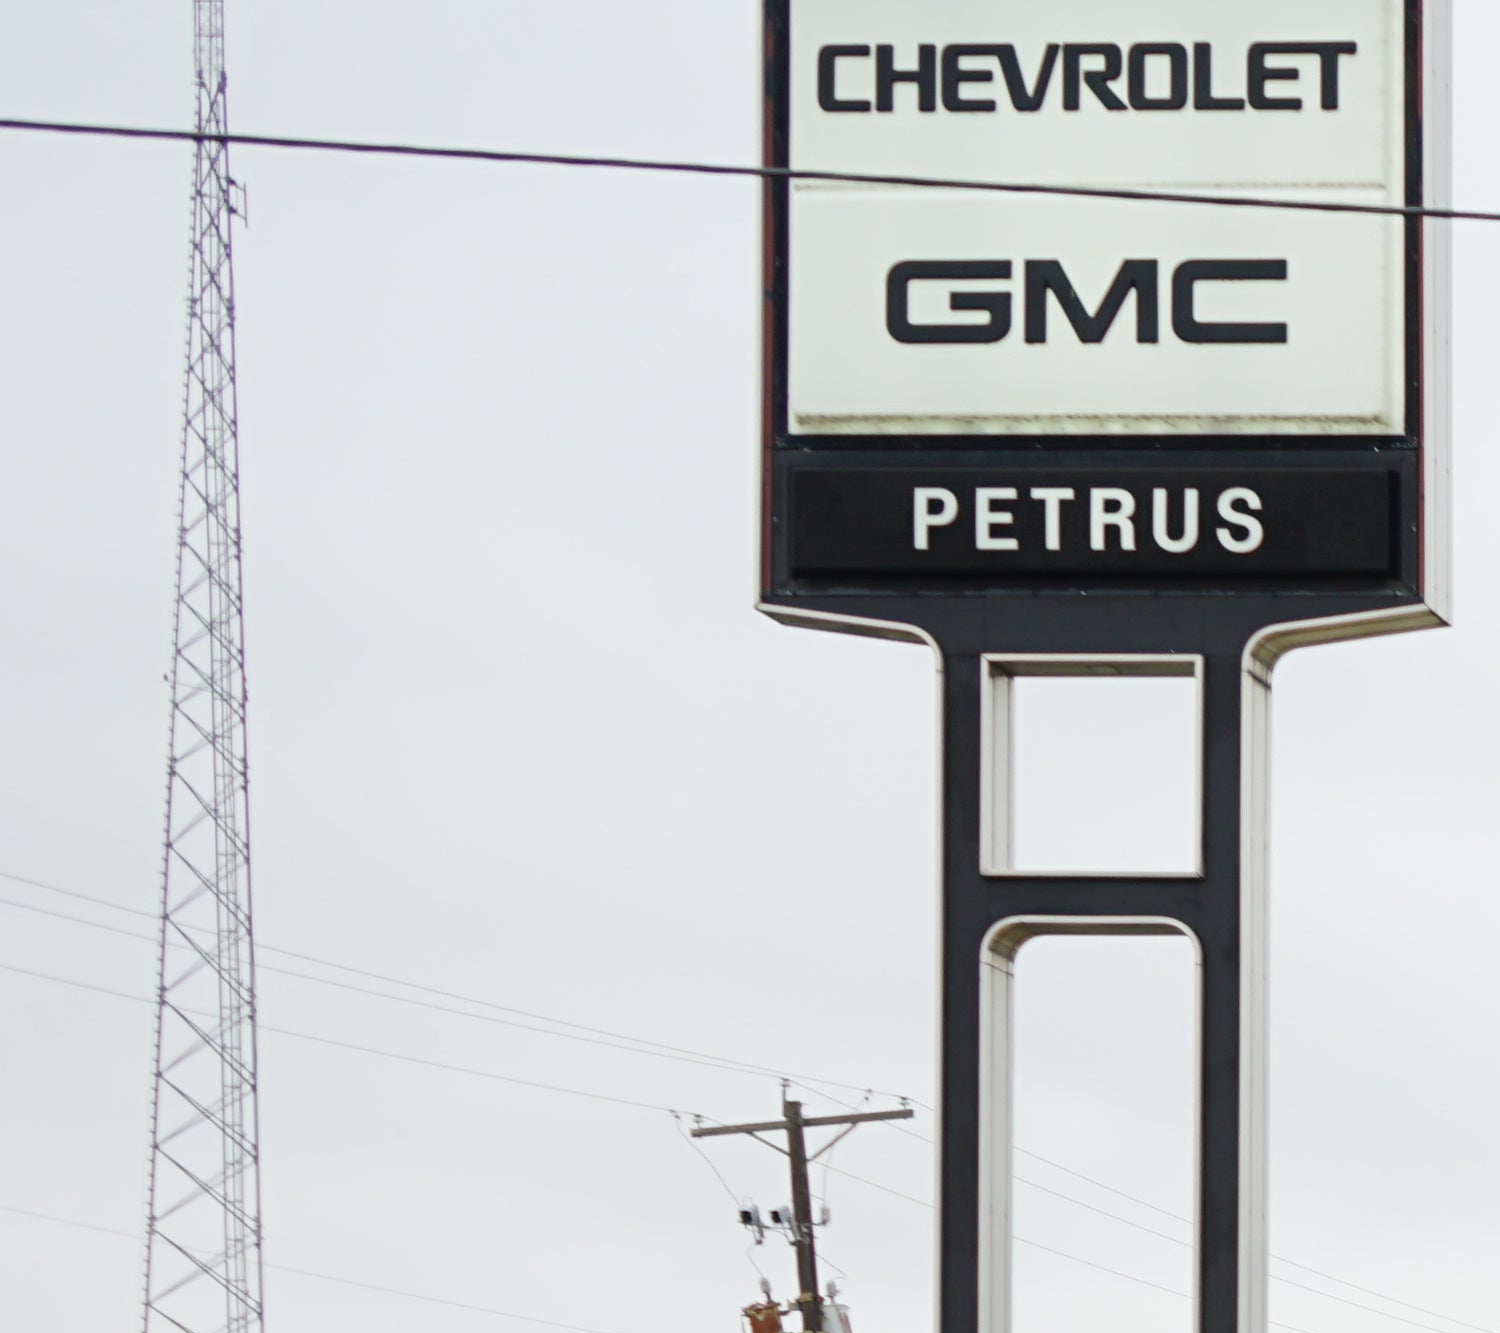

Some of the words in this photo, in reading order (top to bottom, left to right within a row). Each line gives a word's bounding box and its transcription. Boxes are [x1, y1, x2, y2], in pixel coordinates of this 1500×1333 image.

[817, 41, 1357, 113] CHEVROLET
[886, 259, 1287, 344] GMC
[913, 487, 1264, 553] PETRUS
